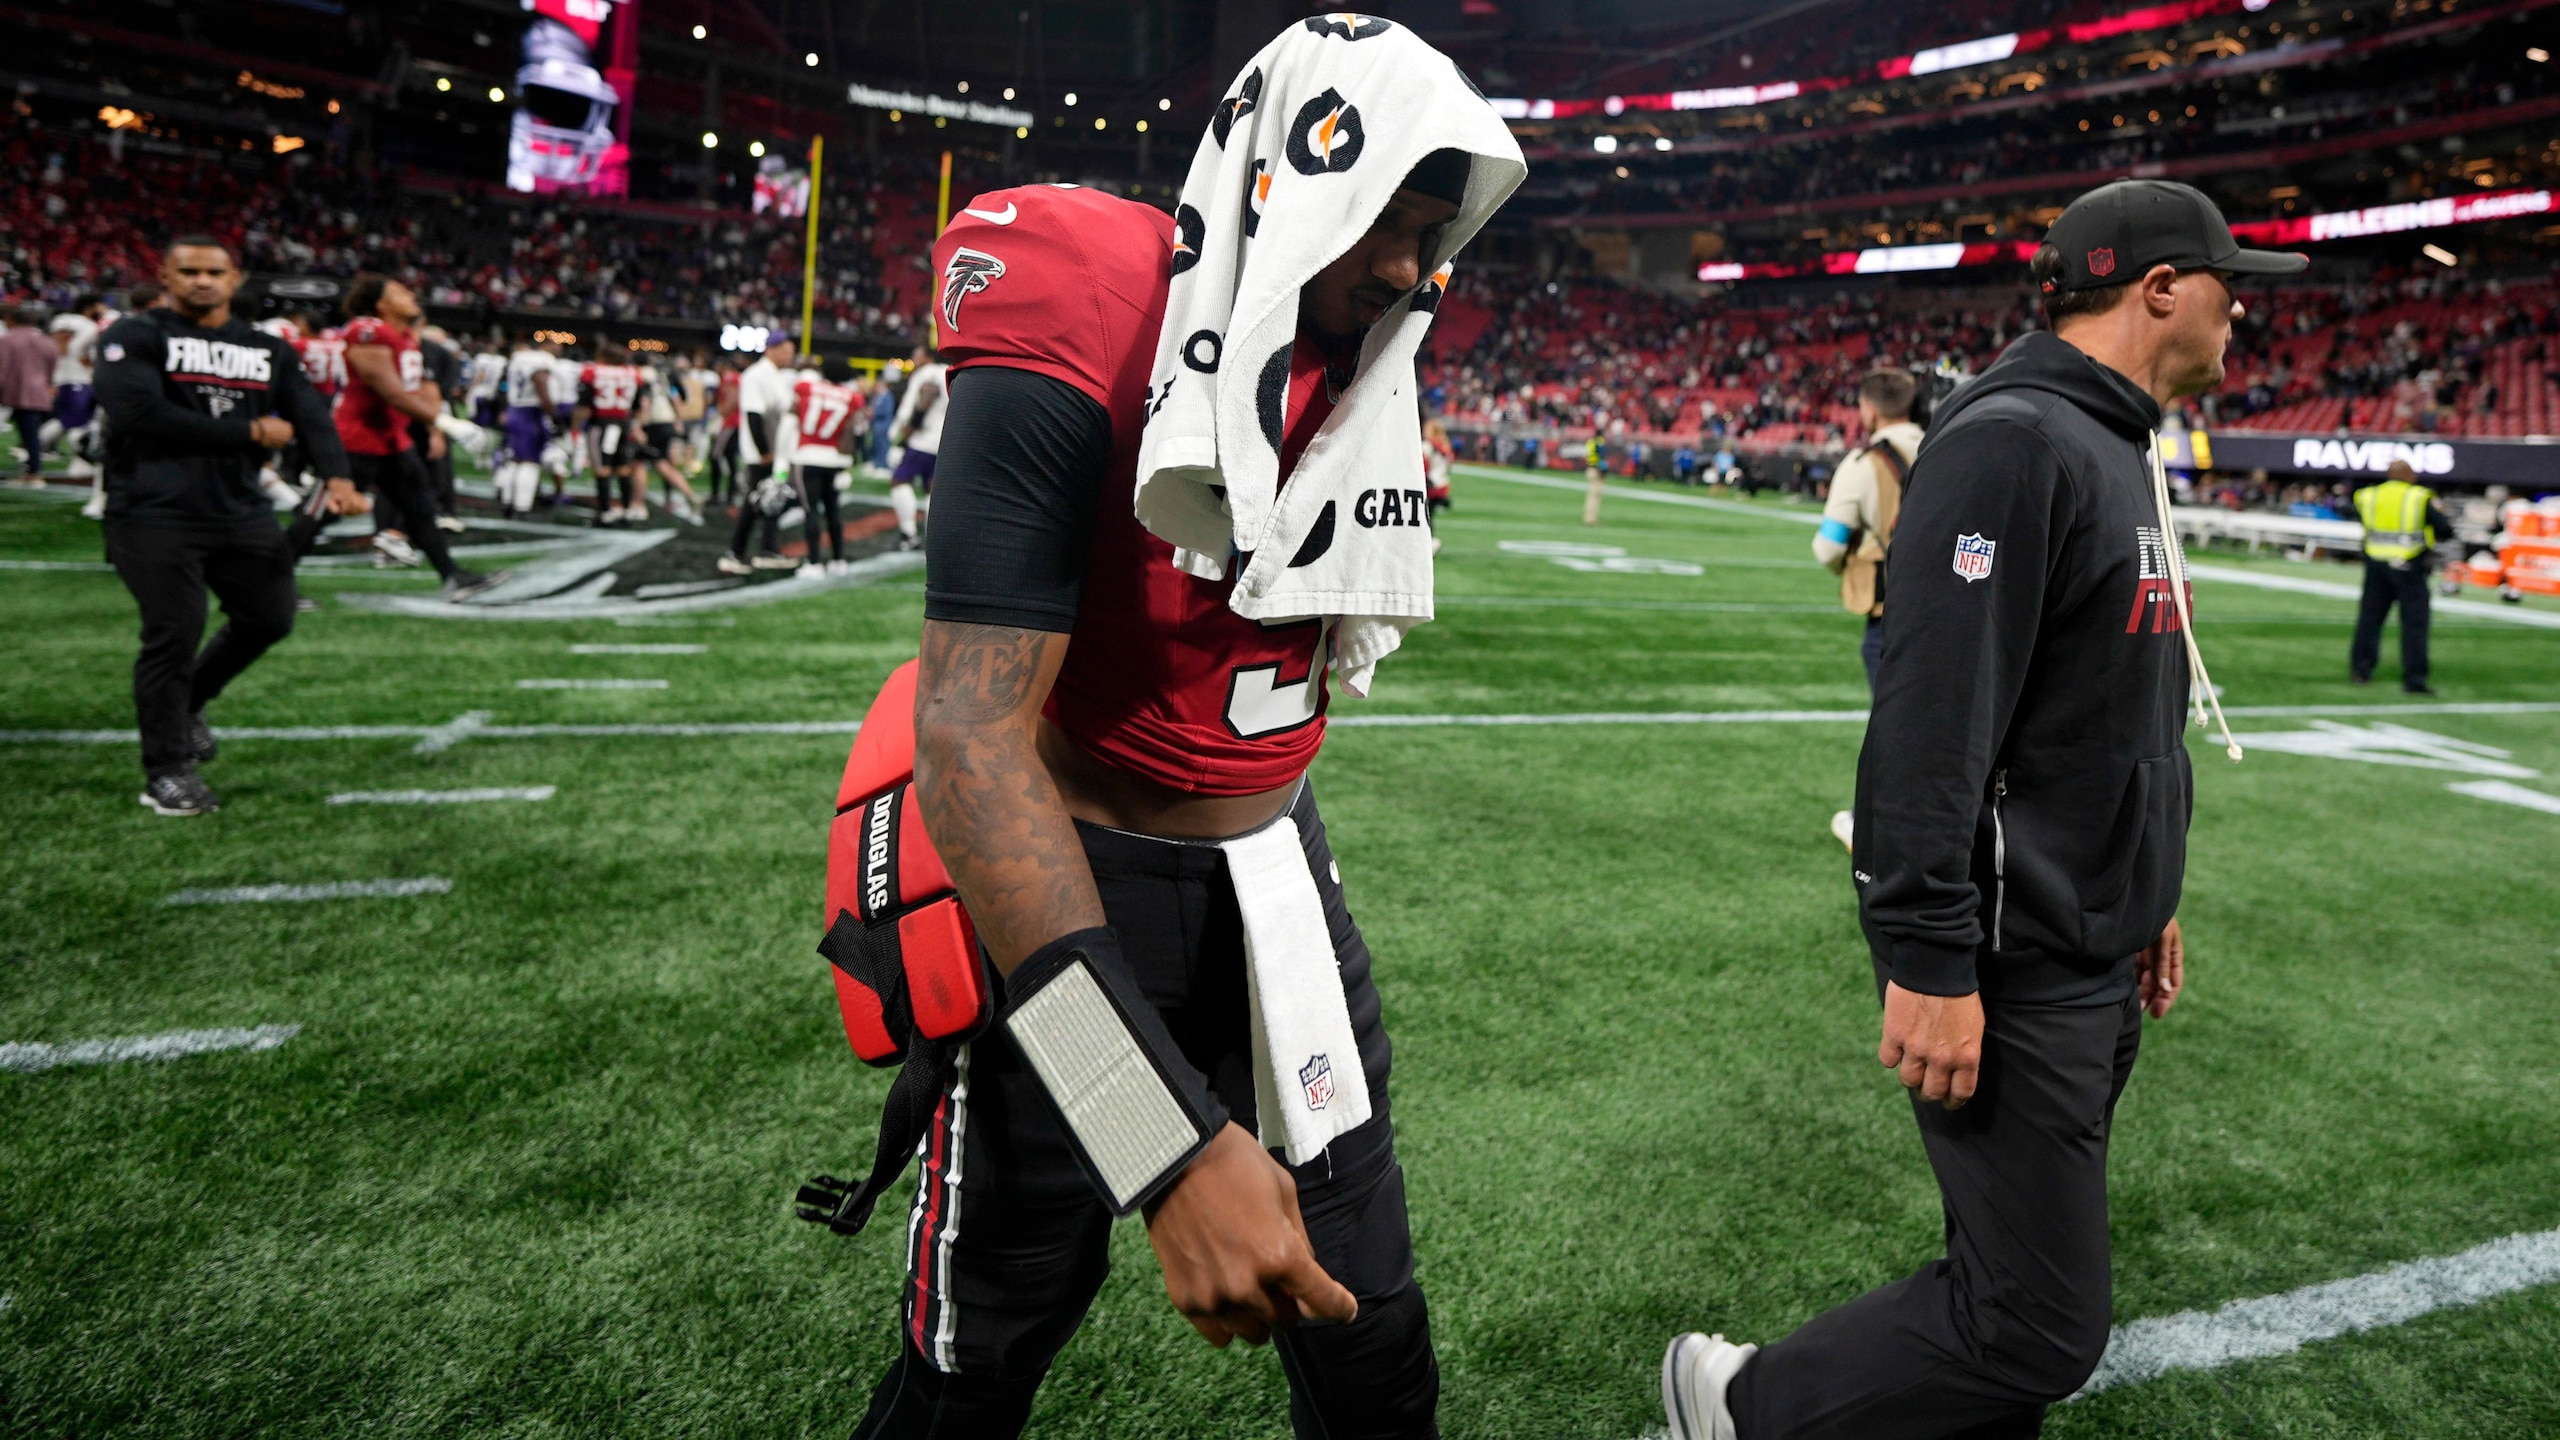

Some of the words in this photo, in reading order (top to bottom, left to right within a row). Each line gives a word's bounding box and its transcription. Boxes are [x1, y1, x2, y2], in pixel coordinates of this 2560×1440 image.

[2310, 198, 2456, 241] FALCONS
[165, 336, 271, 382] FALCONS
[593, 376, 637, 410] 33
[803, 394, 848, 439] 17
[2293, 439, 2454, 474] RAVENS
[1354, 488, 1431, 529] GAT
[1958, 551, 1987, 574] NFL
[867, 791, 894, 911] DOUGLAS
[1308, 1075, 1331, 1105] NFL
